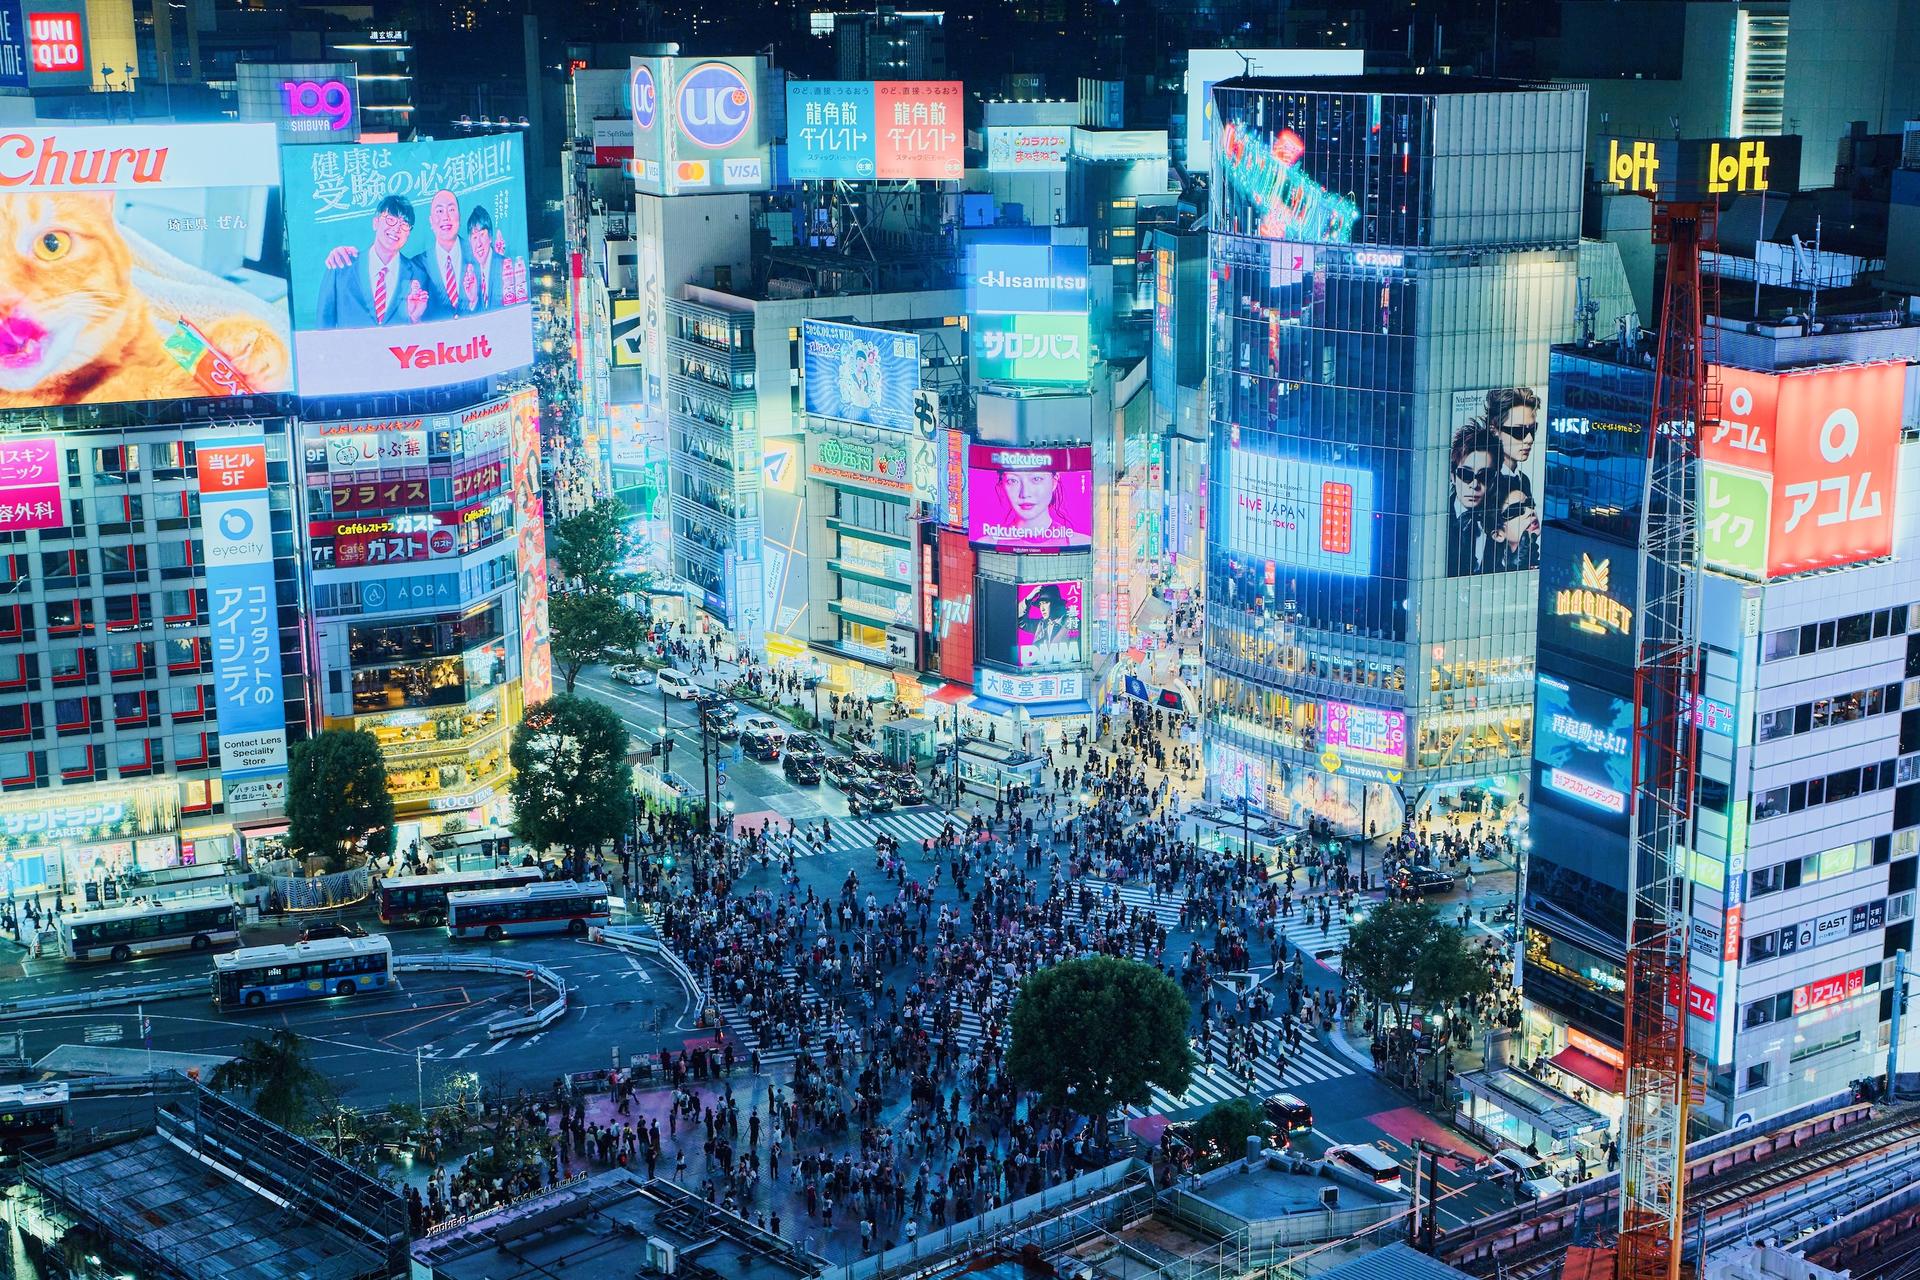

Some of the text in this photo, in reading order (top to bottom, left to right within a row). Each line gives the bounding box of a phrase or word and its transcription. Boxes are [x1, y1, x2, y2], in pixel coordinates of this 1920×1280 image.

[35, 20, 73, 41] UNI
[38, 44, 78, 69] QLO
[284, 81, 351, 130] 109
[805, 101, 858, 126] 龍角散
[893, 101, 947, 126] 龍角散
[291, 119, 331, 132] SHIBUYA
[0, 134, 169, 187] Churu
[311, 147, 392, 178] 健康は
[727, 164, 760, 178] VISA
[979, 270, 1086, 289] Hisamitsu
[388, 334, 493, 370] Yakult
[982, 331, 1081, 360] サロンパス
[319, 418, 423, 436] しゃぶしゃぶバイキング
[1711, 417, 1767, 454] アコム
[0, 446, 51, 464] スキン
[208, 453, 255, 470] 当ビル
[305, 448, 325, 462] 9F
[1001, 452, 1052, 467] Rakuten
[221, 469, 246, 486] 5F
[333, 481, 426, 506] プライス
[1784, 471, 1883, 535] アコム
[1239, 493, 1306, 520] LIVE JAPAN
[396, 514, 442, 534] ガスト
[982, 523, 1074, 539] Rakuten Mobile
[212, 543, 264, 557] eyecity
[311, 546, 334, 561] 7F
[367, 535, 423, 561] ガスト
[398, 583, 448, 599] AOBA
[1557, 587, 1633, 636] MAGNET
[215, 587, 251, 707] アイシティ
[248, 585, 275, 705] コンタクトの
[987, 675, 1075, 697] 大盛堂書店
[224, 735, 282, 749] Contact Lens
[1551, 713, 1628, 756] 再起動せよ!!
[242, 757, 267, 766] Store
[235, 784, 266, 794] ハチ公前
[1563, 775, 1623, 808] アスカインデックス
[4, 801, 124, 835] サンドラッグ
[1694, 924, 1720, 941] EAST
[1818, 915, 1848, 932] EAST
[1782, 937, 1794, 951] 4F
[1813, 980, 1844, 1002] アコム
[1848, 976, 1862, 991] 3F
